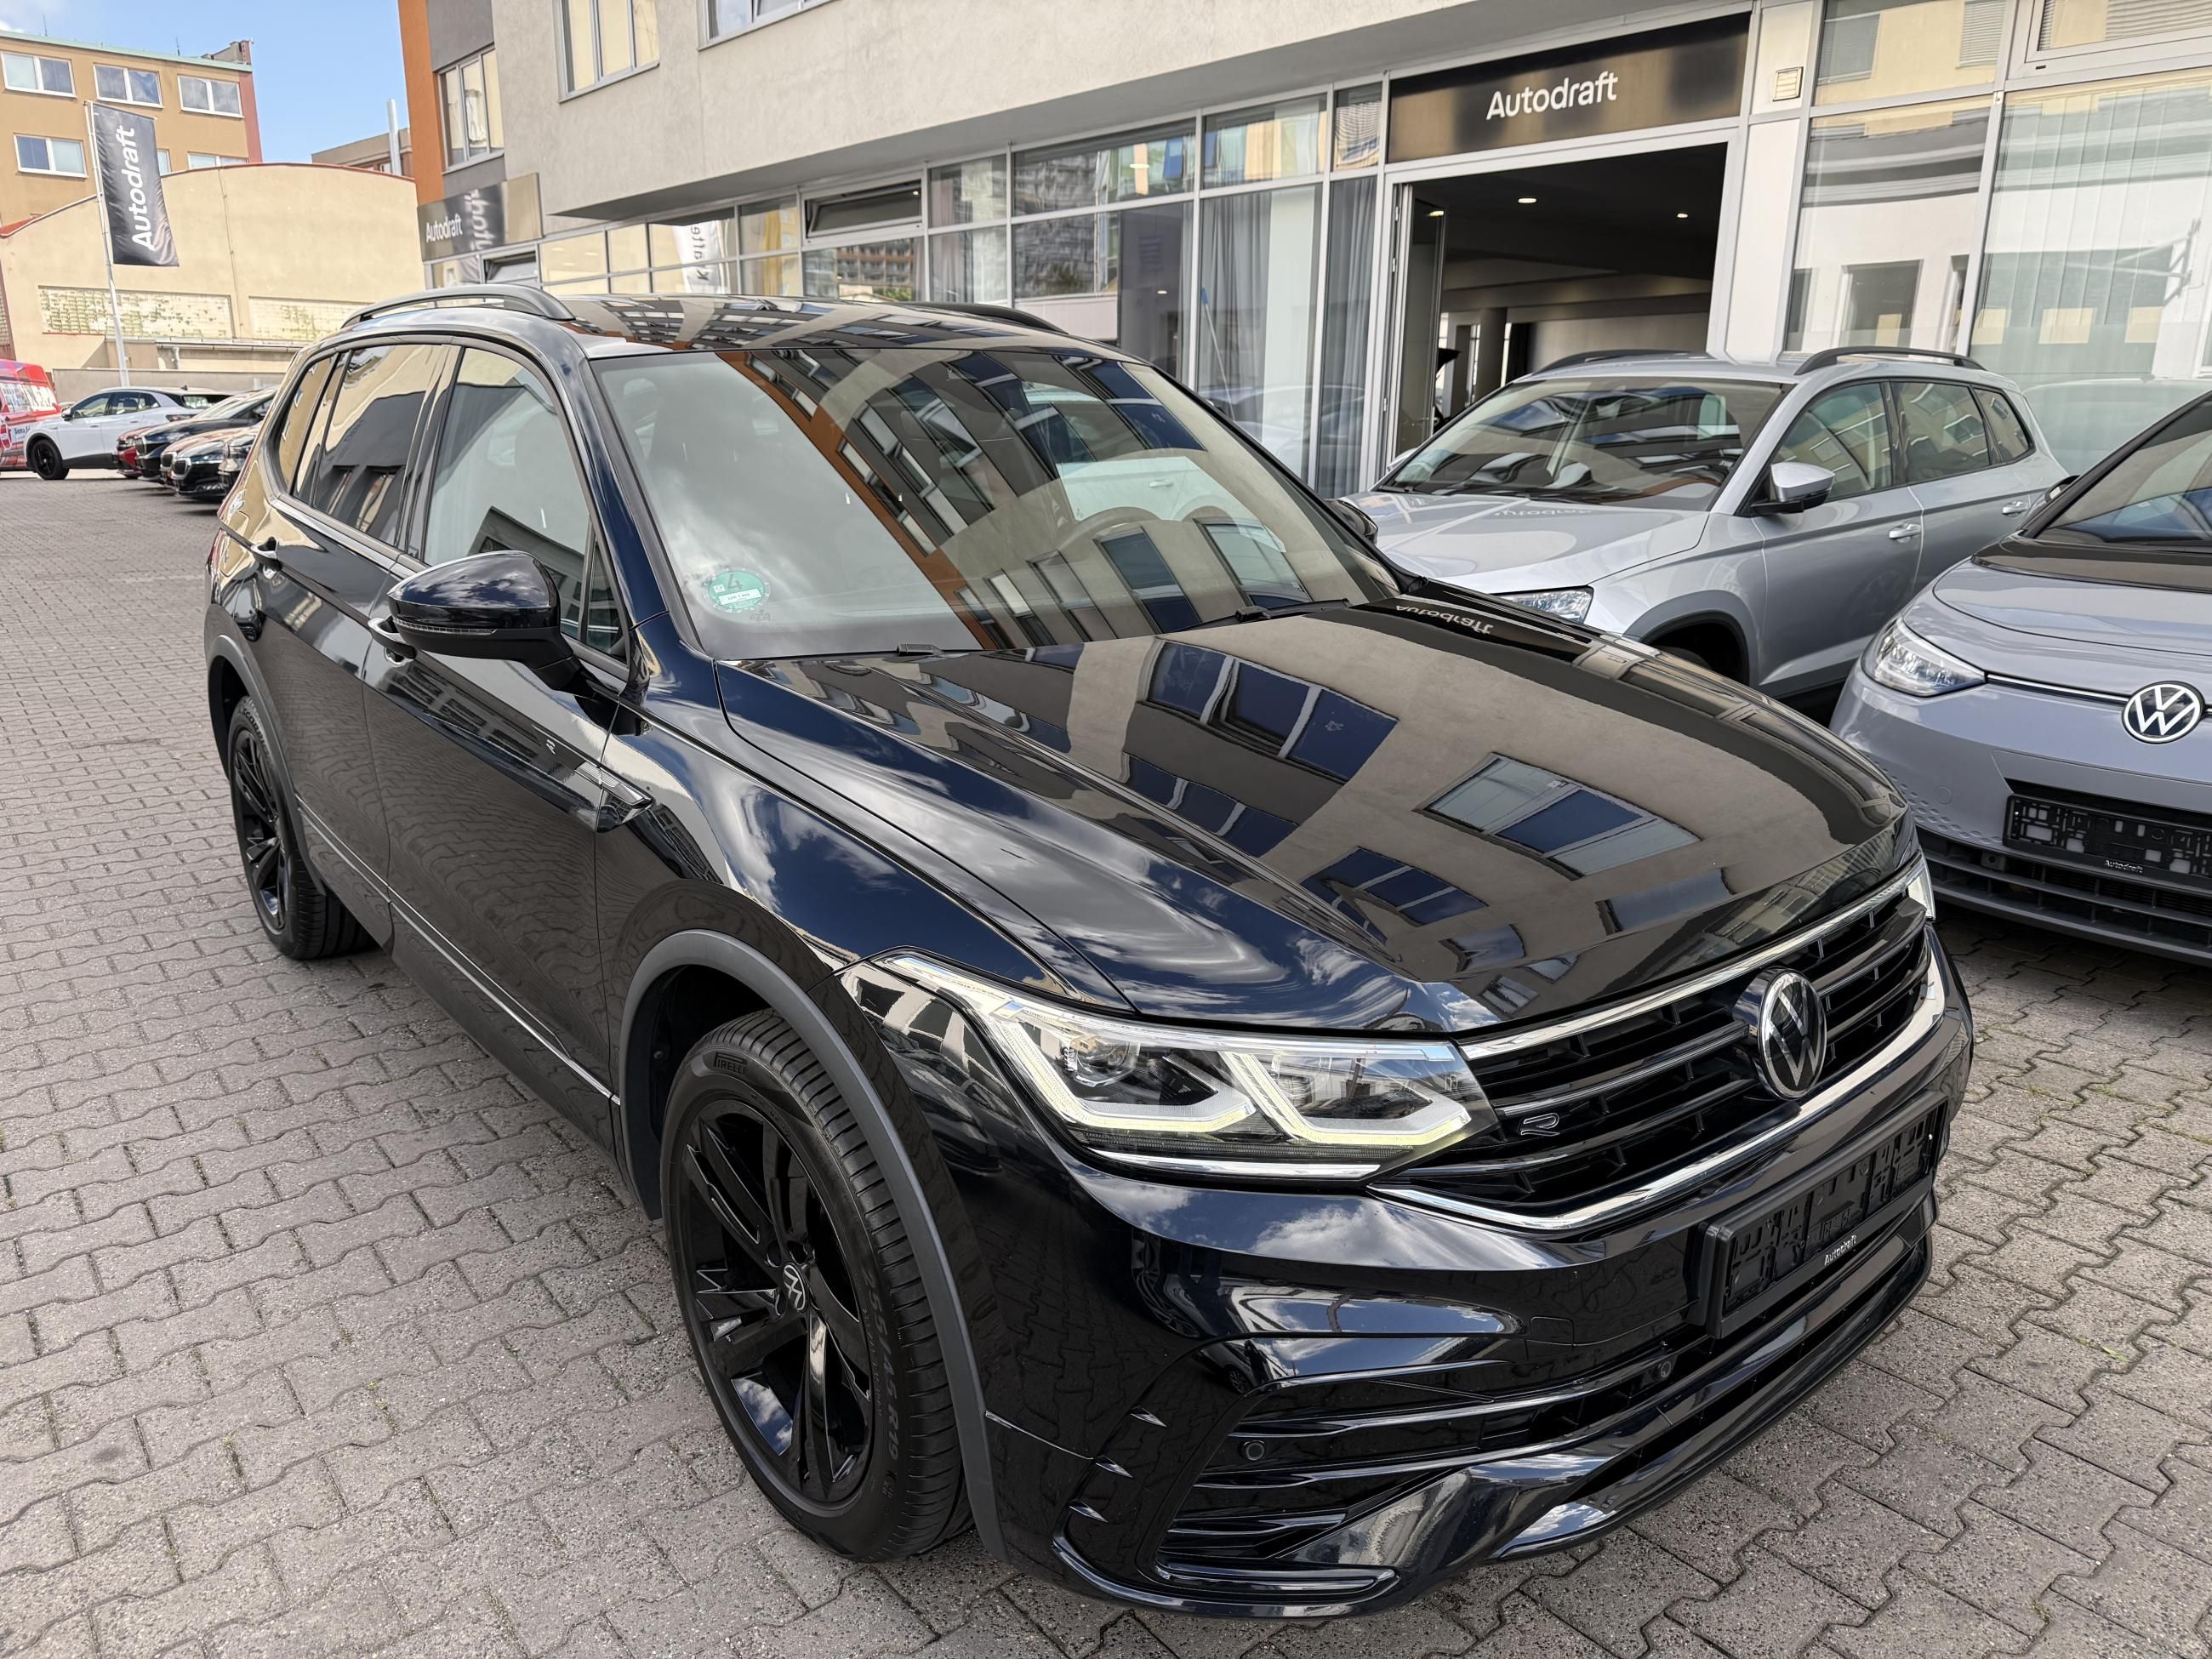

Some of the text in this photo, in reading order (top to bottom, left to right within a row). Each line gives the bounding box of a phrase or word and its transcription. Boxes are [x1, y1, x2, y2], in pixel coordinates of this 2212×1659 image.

[1485, 71, 1619, 121] Autodraft
[116, 125, 155, 252] Autodraft
[425, 213, 464, 243] Autodraft
[727, 573, 744, 590] 4
[2124, 683, 2201, 742] VW
[1760, 972, 1827, 1099] VW
[713, 1052, 748, 1076] PIRELLI
[1520, 1112, 1561, 1137] R
[1824, 1234, 1857, 1266] Autodraft
